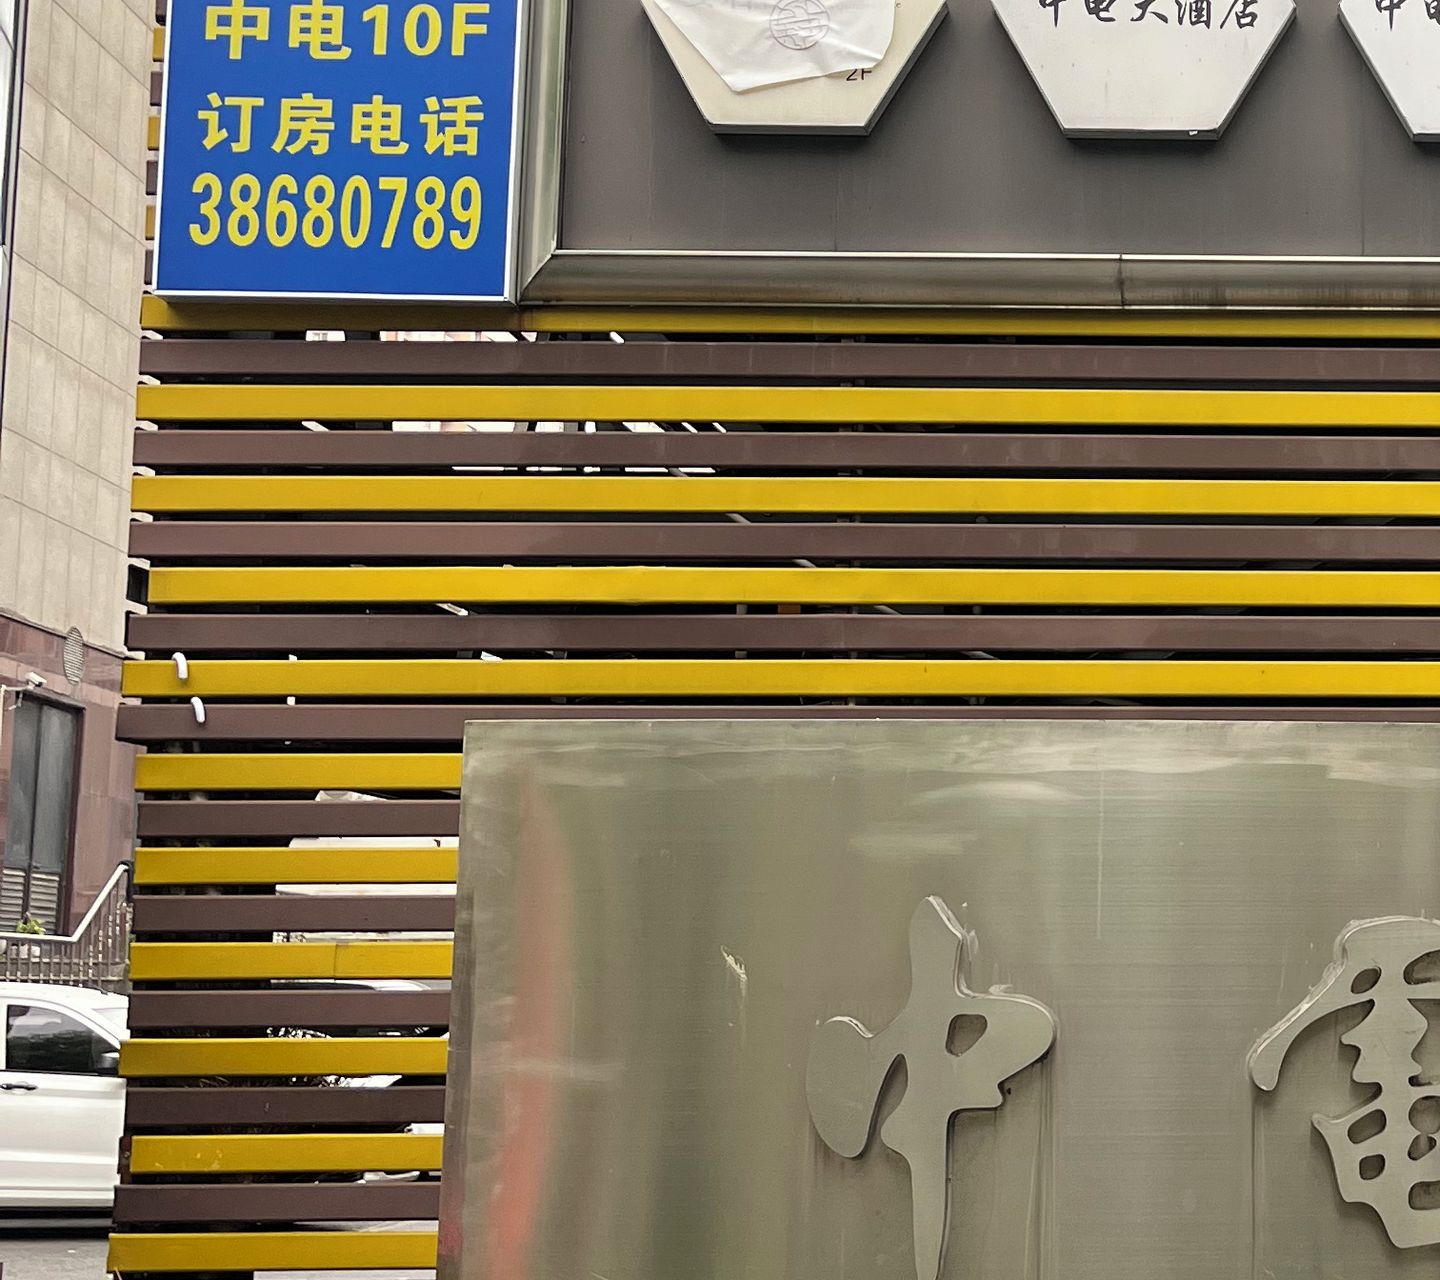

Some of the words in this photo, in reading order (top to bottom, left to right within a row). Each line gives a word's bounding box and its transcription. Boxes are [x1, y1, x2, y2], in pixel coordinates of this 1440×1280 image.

[197, 92, 486, 157] 订房电话
[188, 172, 483, 251] 38680789
